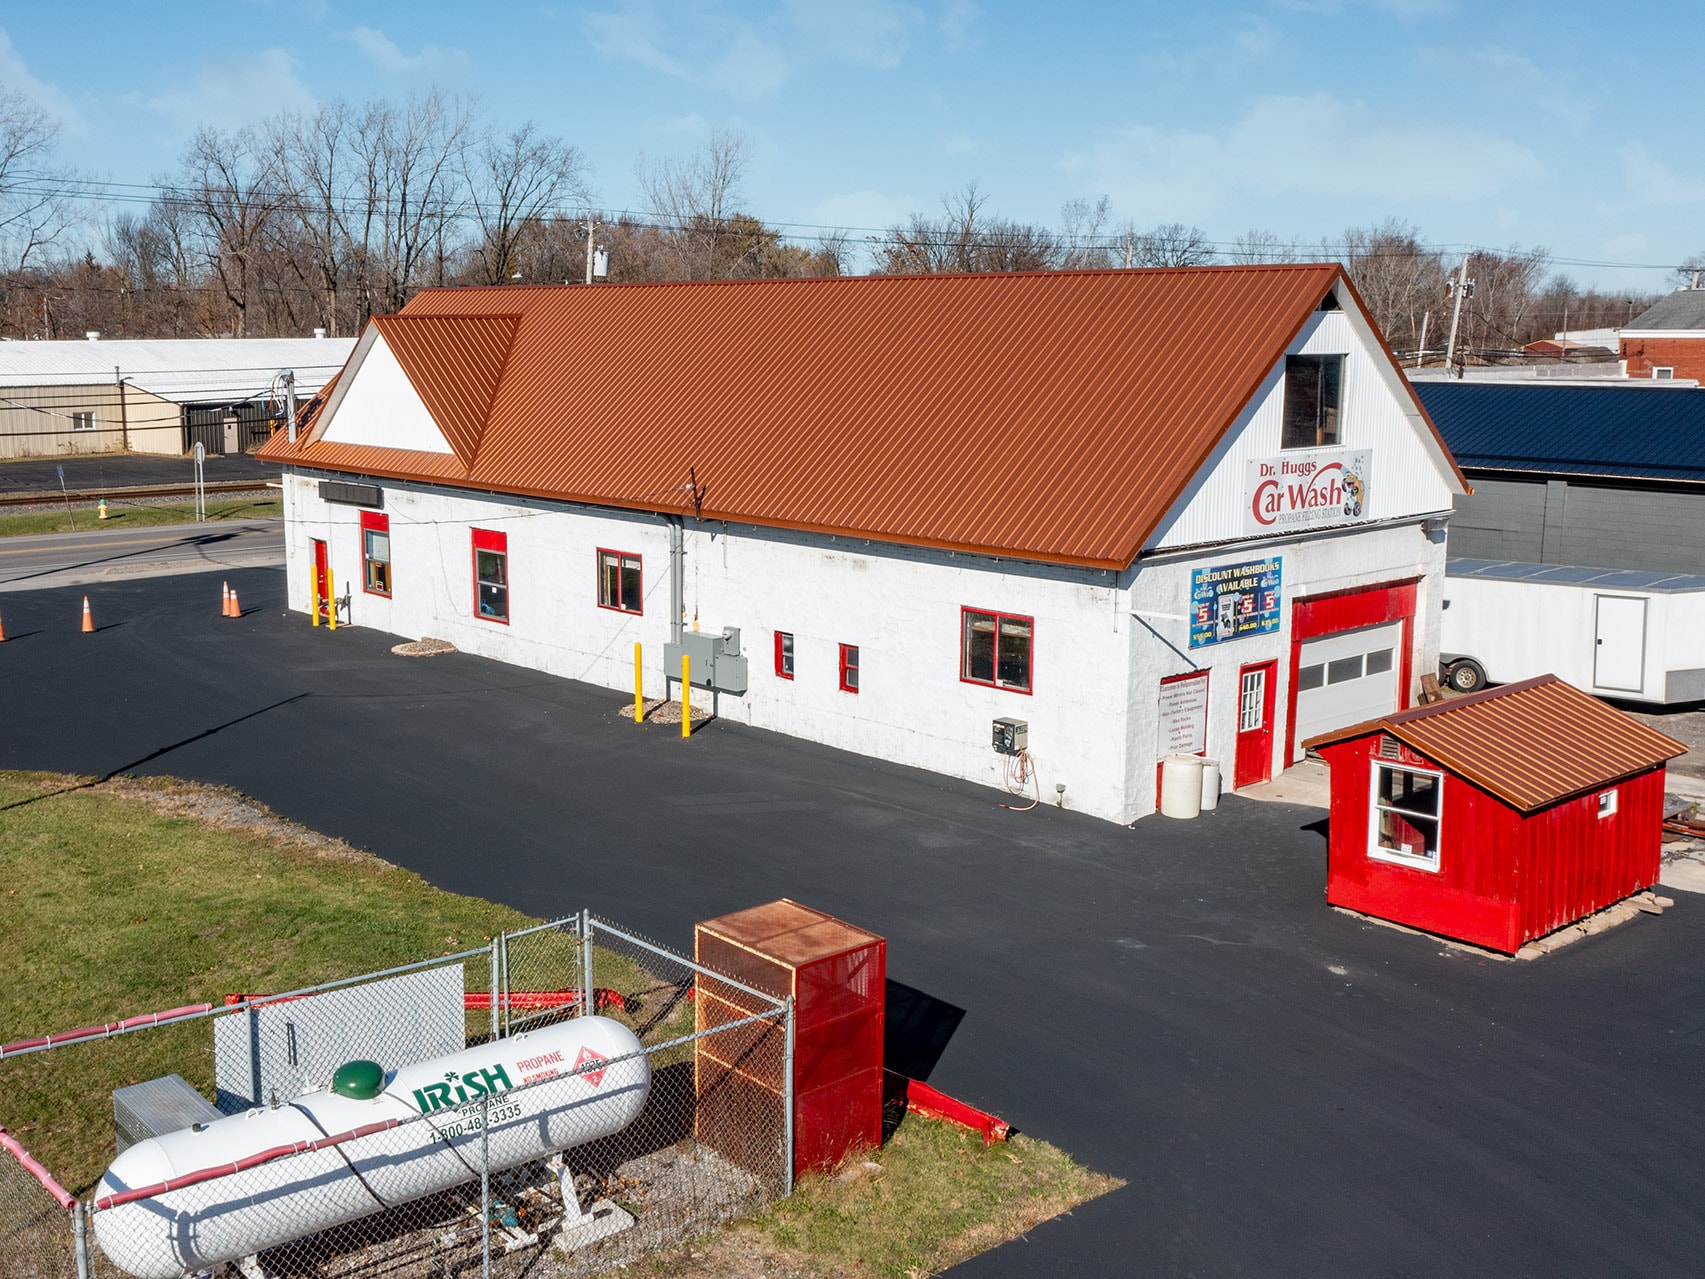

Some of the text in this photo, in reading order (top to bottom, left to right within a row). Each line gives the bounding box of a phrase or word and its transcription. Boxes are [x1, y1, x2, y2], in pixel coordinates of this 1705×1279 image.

[1260, 461, 1317, 477] Dr. Huggs
[1252, 476, 1342, 525] Car Wash
[1195, 562, 1279, 584] DISCOUNT WASHBOOKS
[1219, 577, 1258, 592] AVAILABLE
[516, 1050, 565, 1073] PROPANE
[532, 1068, 559, 1082] SMOKING
[462, 1097, 510, 1117] PROANE
[430, 1103, 522, 1145] 1-800-48-3335
